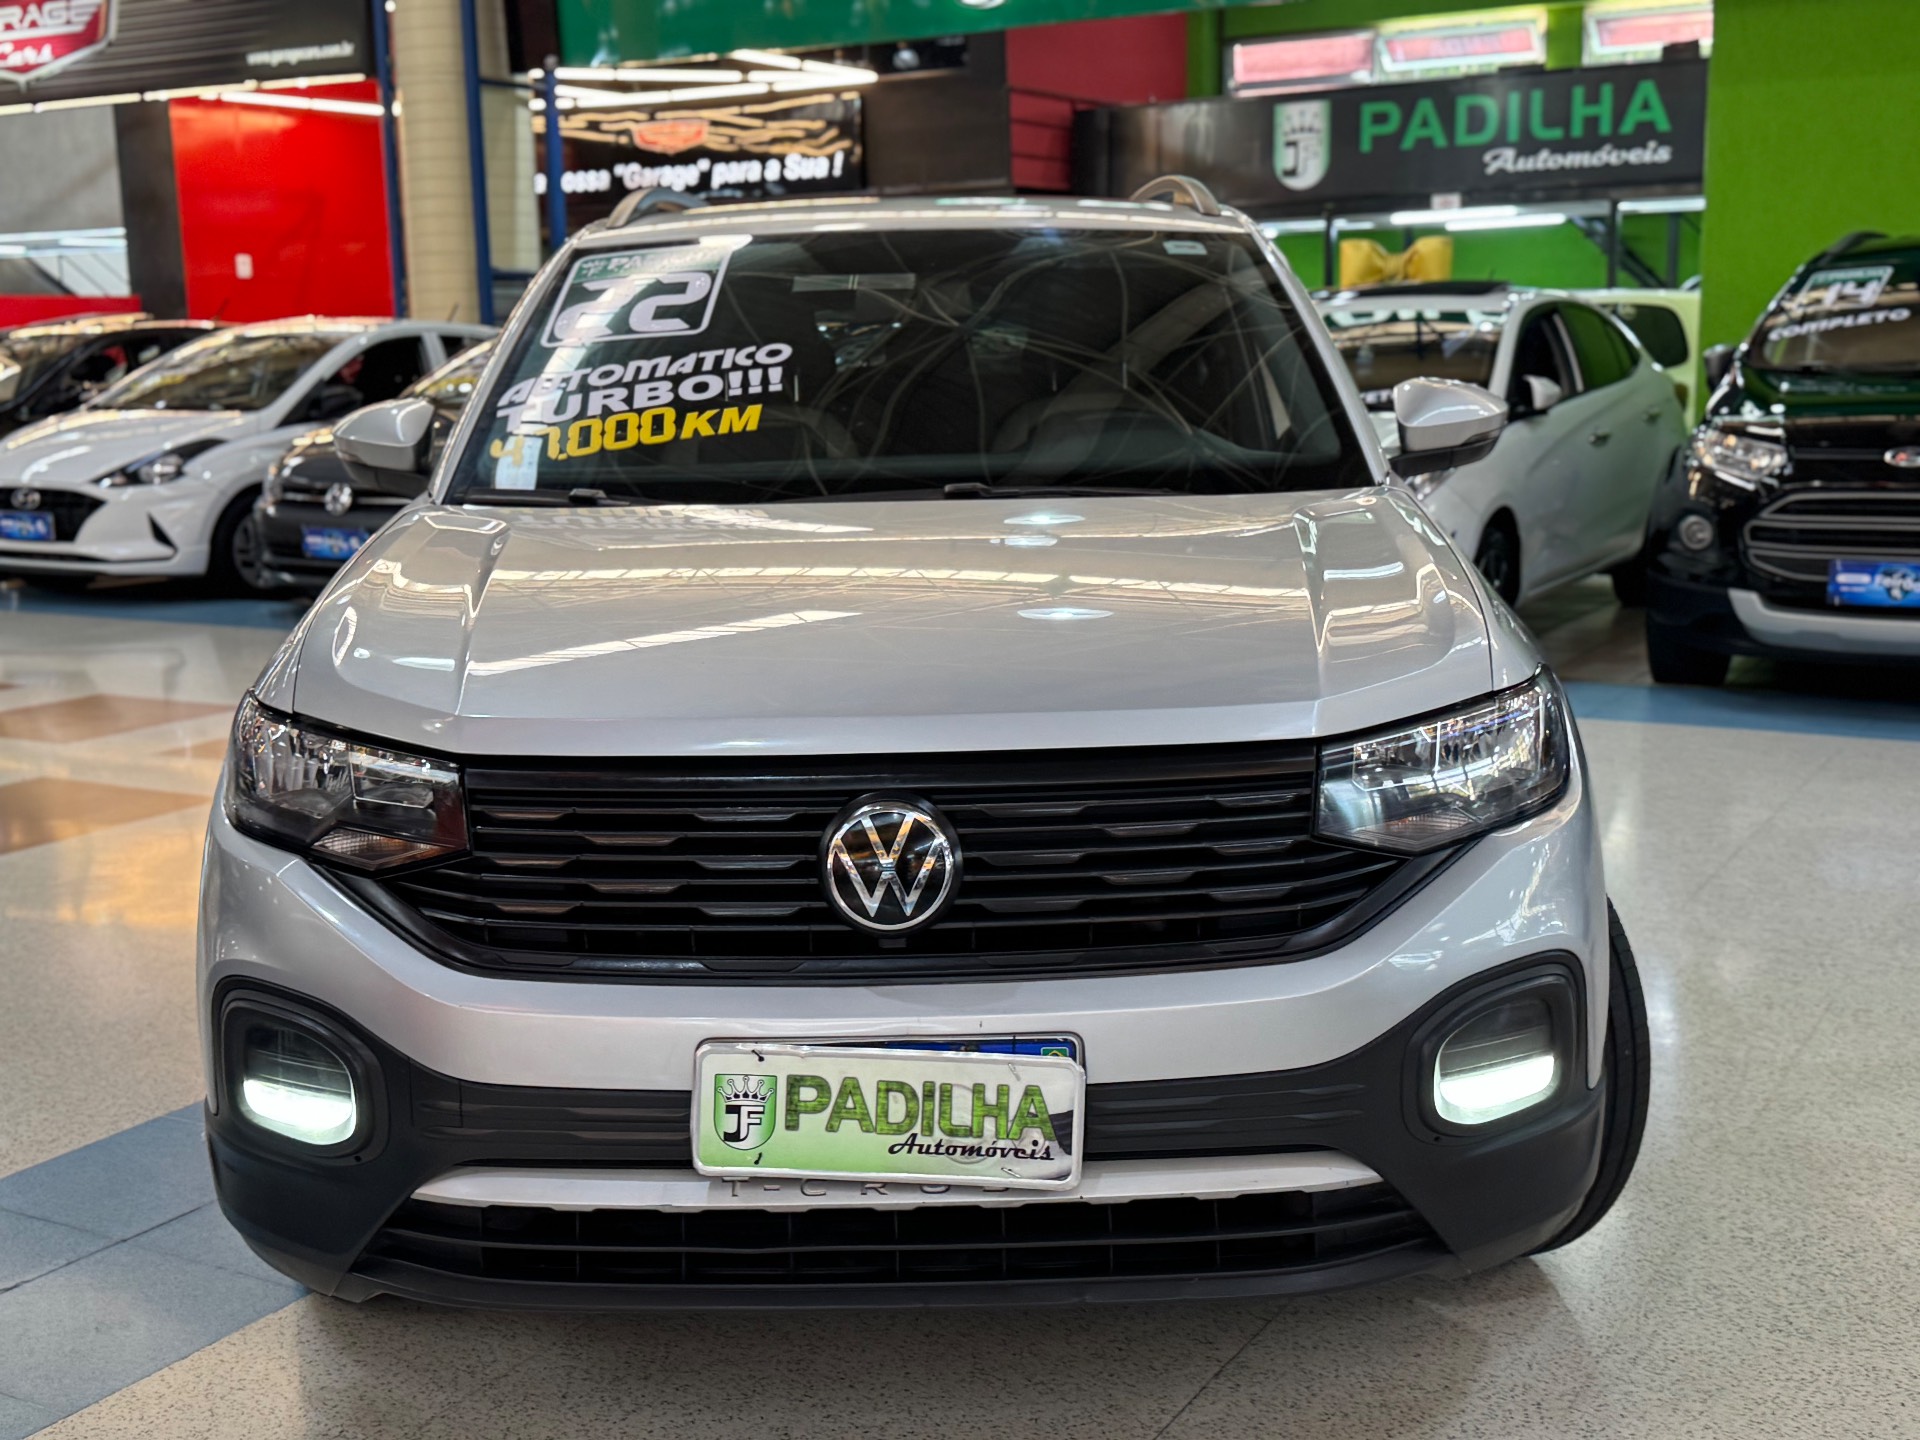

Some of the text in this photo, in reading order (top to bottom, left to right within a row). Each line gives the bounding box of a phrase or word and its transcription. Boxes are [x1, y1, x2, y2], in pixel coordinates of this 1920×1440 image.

[1359, 79, 1672, 154] PADILHA
[614, 158, 711, 193] "Garage"
[711, 160, 763, 190] para
[764, 158, 782, 183] a
[783, 151, 830, 182] Sua
[1483, 140, 1673, 176] Automóveis
[553, 271, 712, 341] 22
[1768, 308, 1911, 341] COMPLETO
[496, 343, 793, 407] AUTOMATICO
[496, 366, 784, 433] TURBO!!!
[680, 403, 763, 440] KM
[723, 1104, 764, 1143] JF
[784, 1074, 1057, 1142] PADILHA
[888, 1132, 1055, 1162] Automóveis
